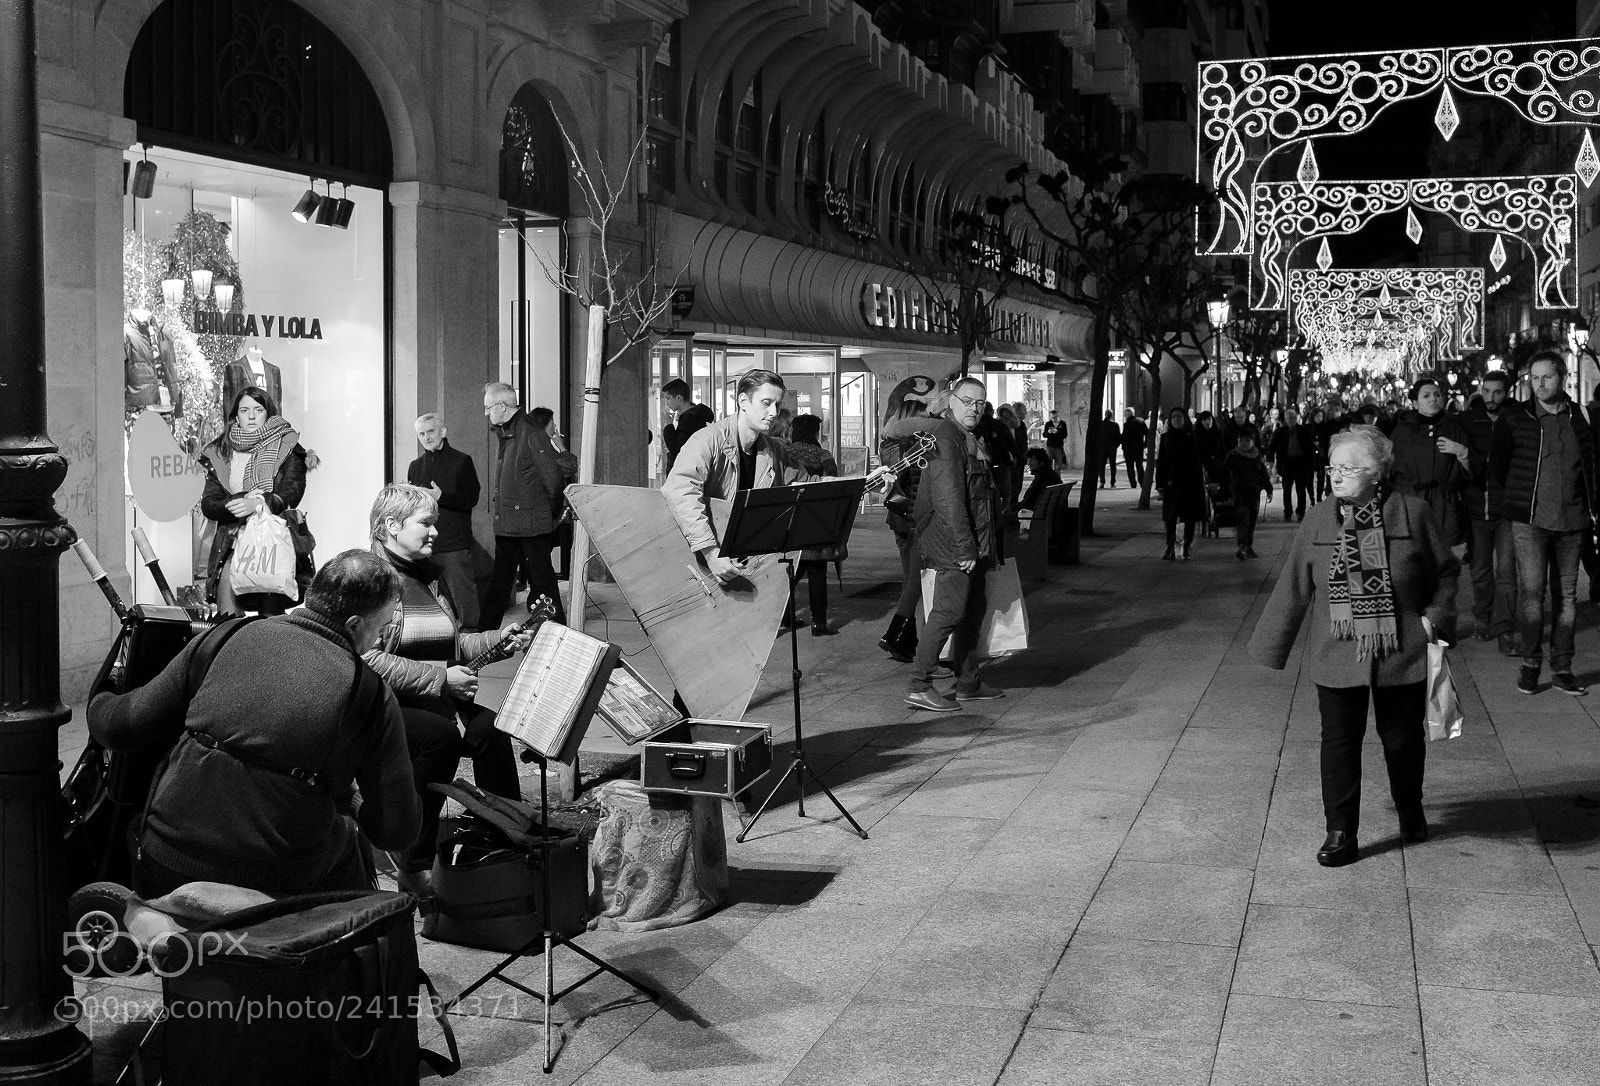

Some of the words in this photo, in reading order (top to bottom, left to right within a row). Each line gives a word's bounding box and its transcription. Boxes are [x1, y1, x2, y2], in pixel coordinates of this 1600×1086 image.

[872, 283, 961, 335] EDIFICIO
[194, 310, 259, 337] BIMBA
[261, 314, 275, 338] Y
[278, 315, 323, 340] LOLA
[1005, 362, 1036, 371] PASEO
[150, 454, 195, 479] REBA
[236, 543, 277, 576] H&M
